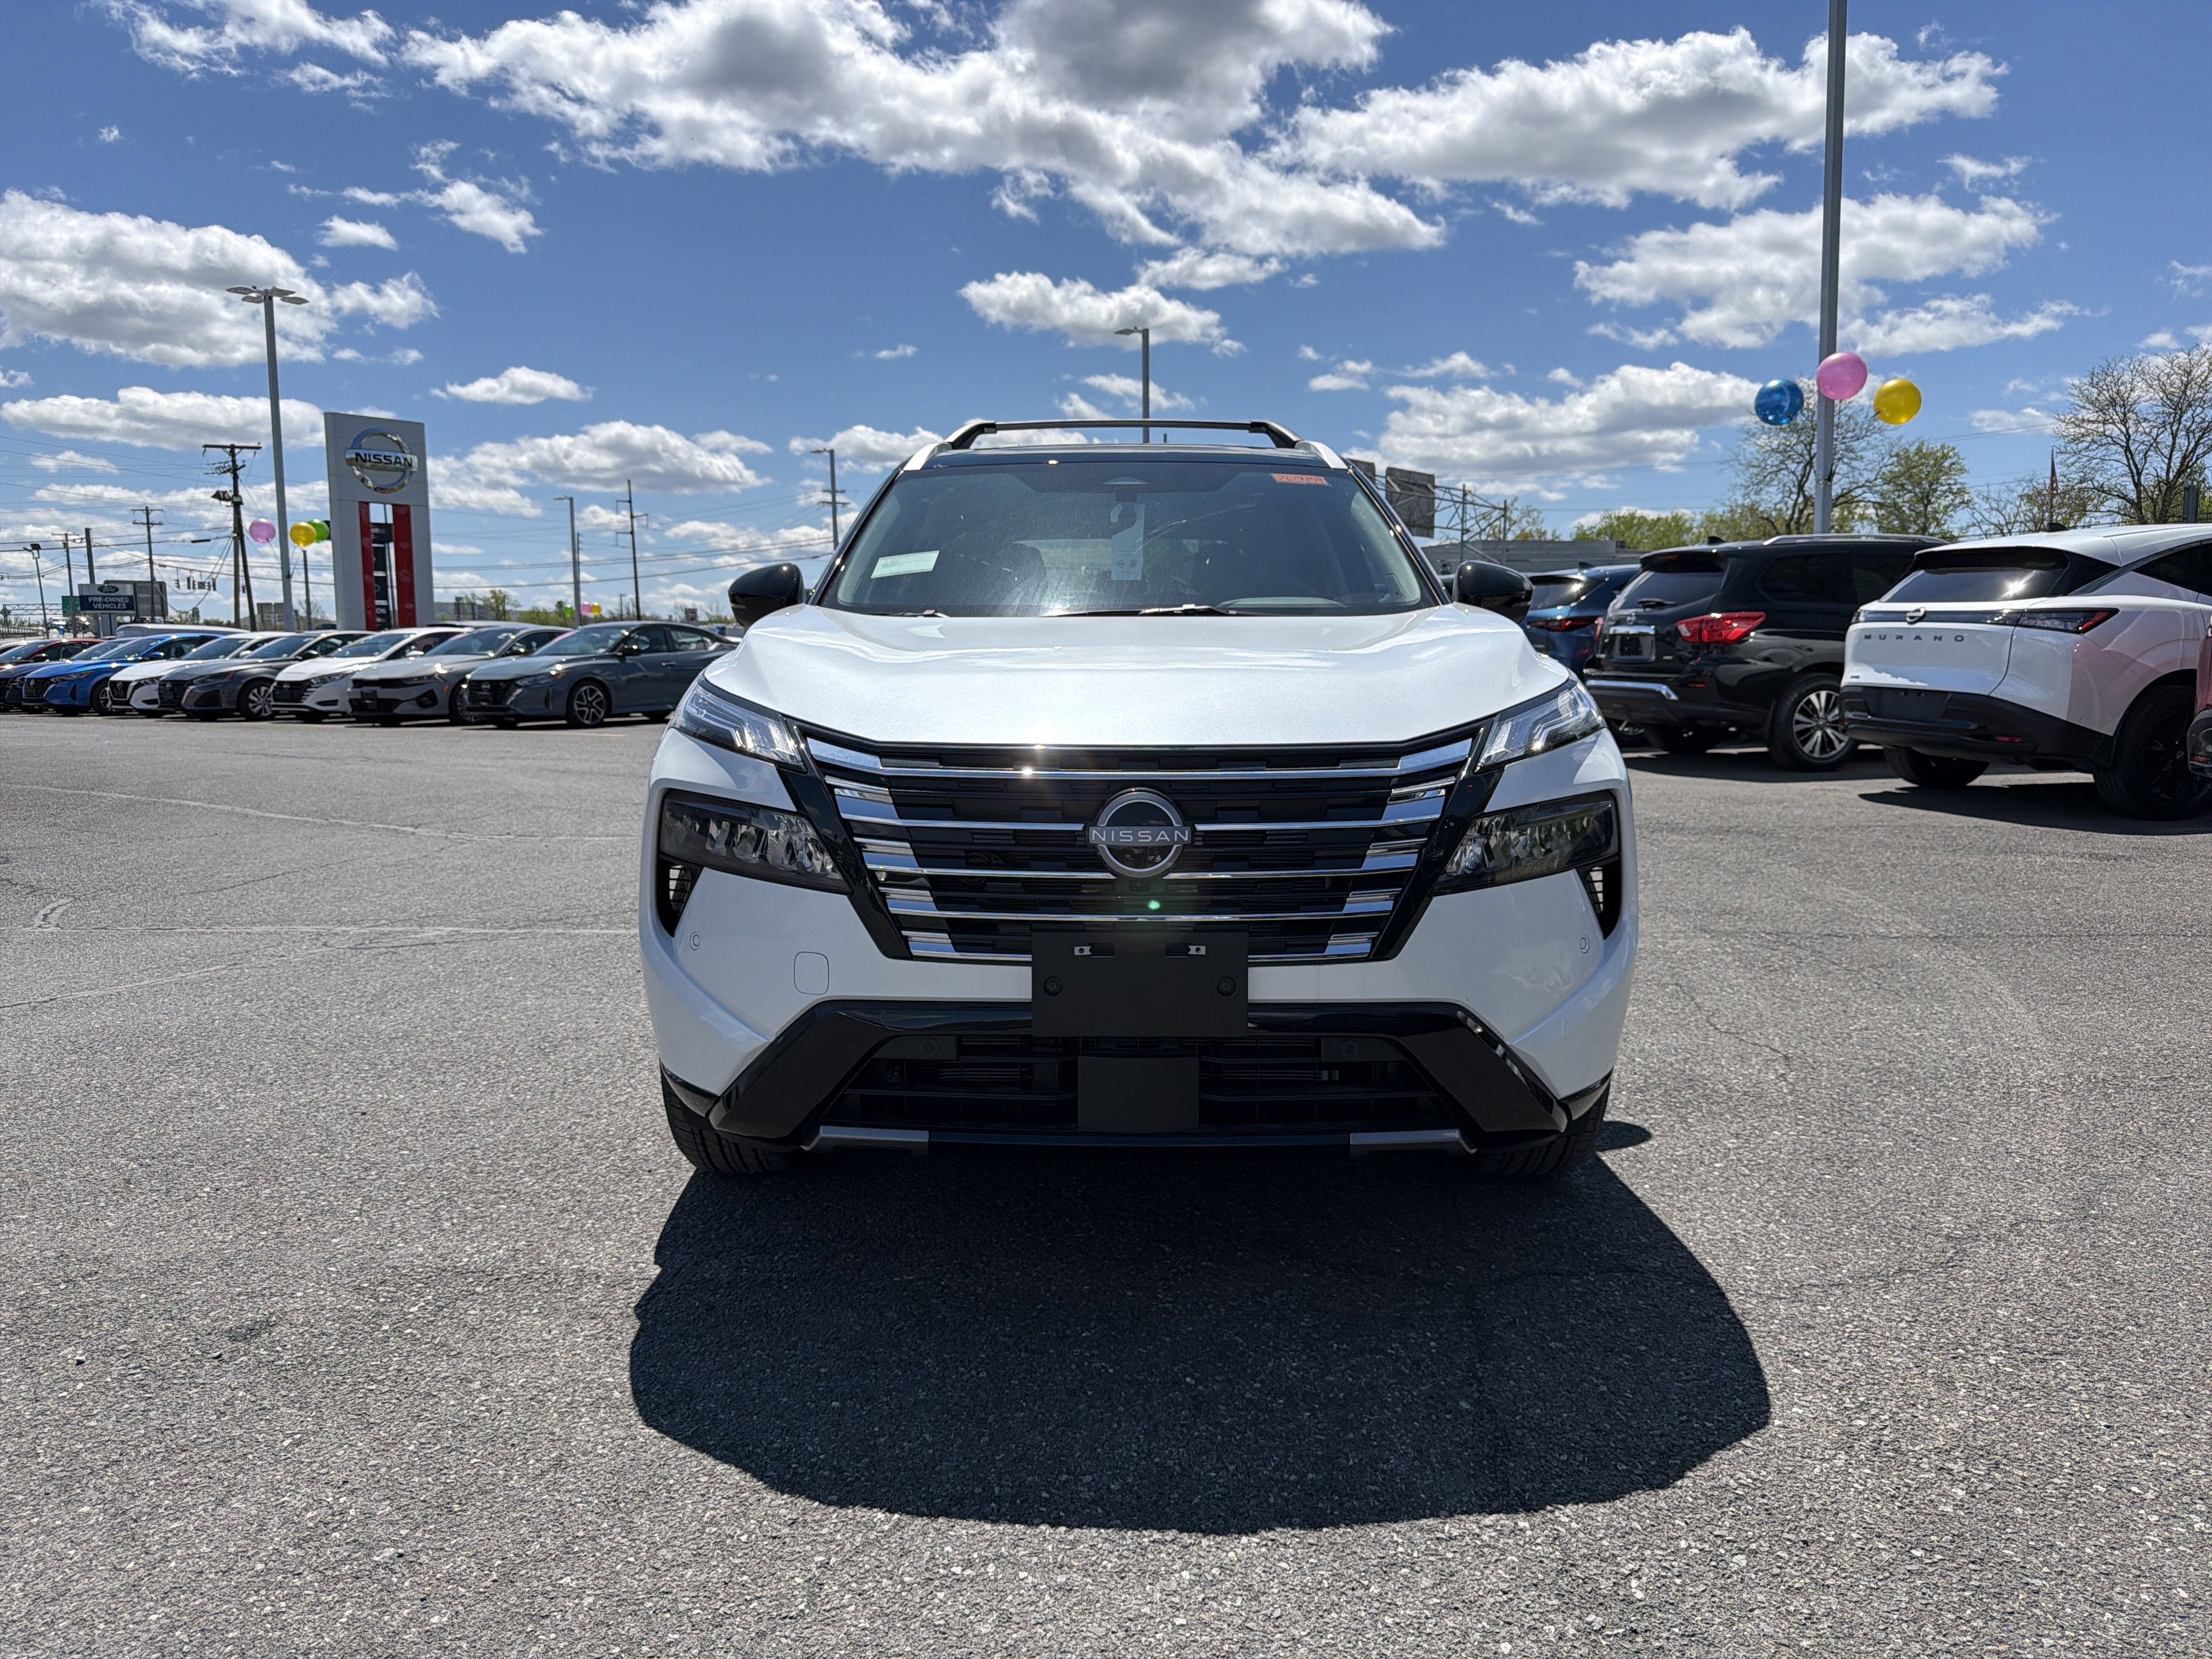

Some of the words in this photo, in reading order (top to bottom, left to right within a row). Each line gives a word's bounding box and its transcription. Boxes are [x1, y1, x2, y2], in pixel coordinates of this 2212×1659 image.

[354, 452, 413, 467] NISSAN
[1864, 634, 1965, 642] MURANO
[1092, 830, 1189, 842] NISSAN
